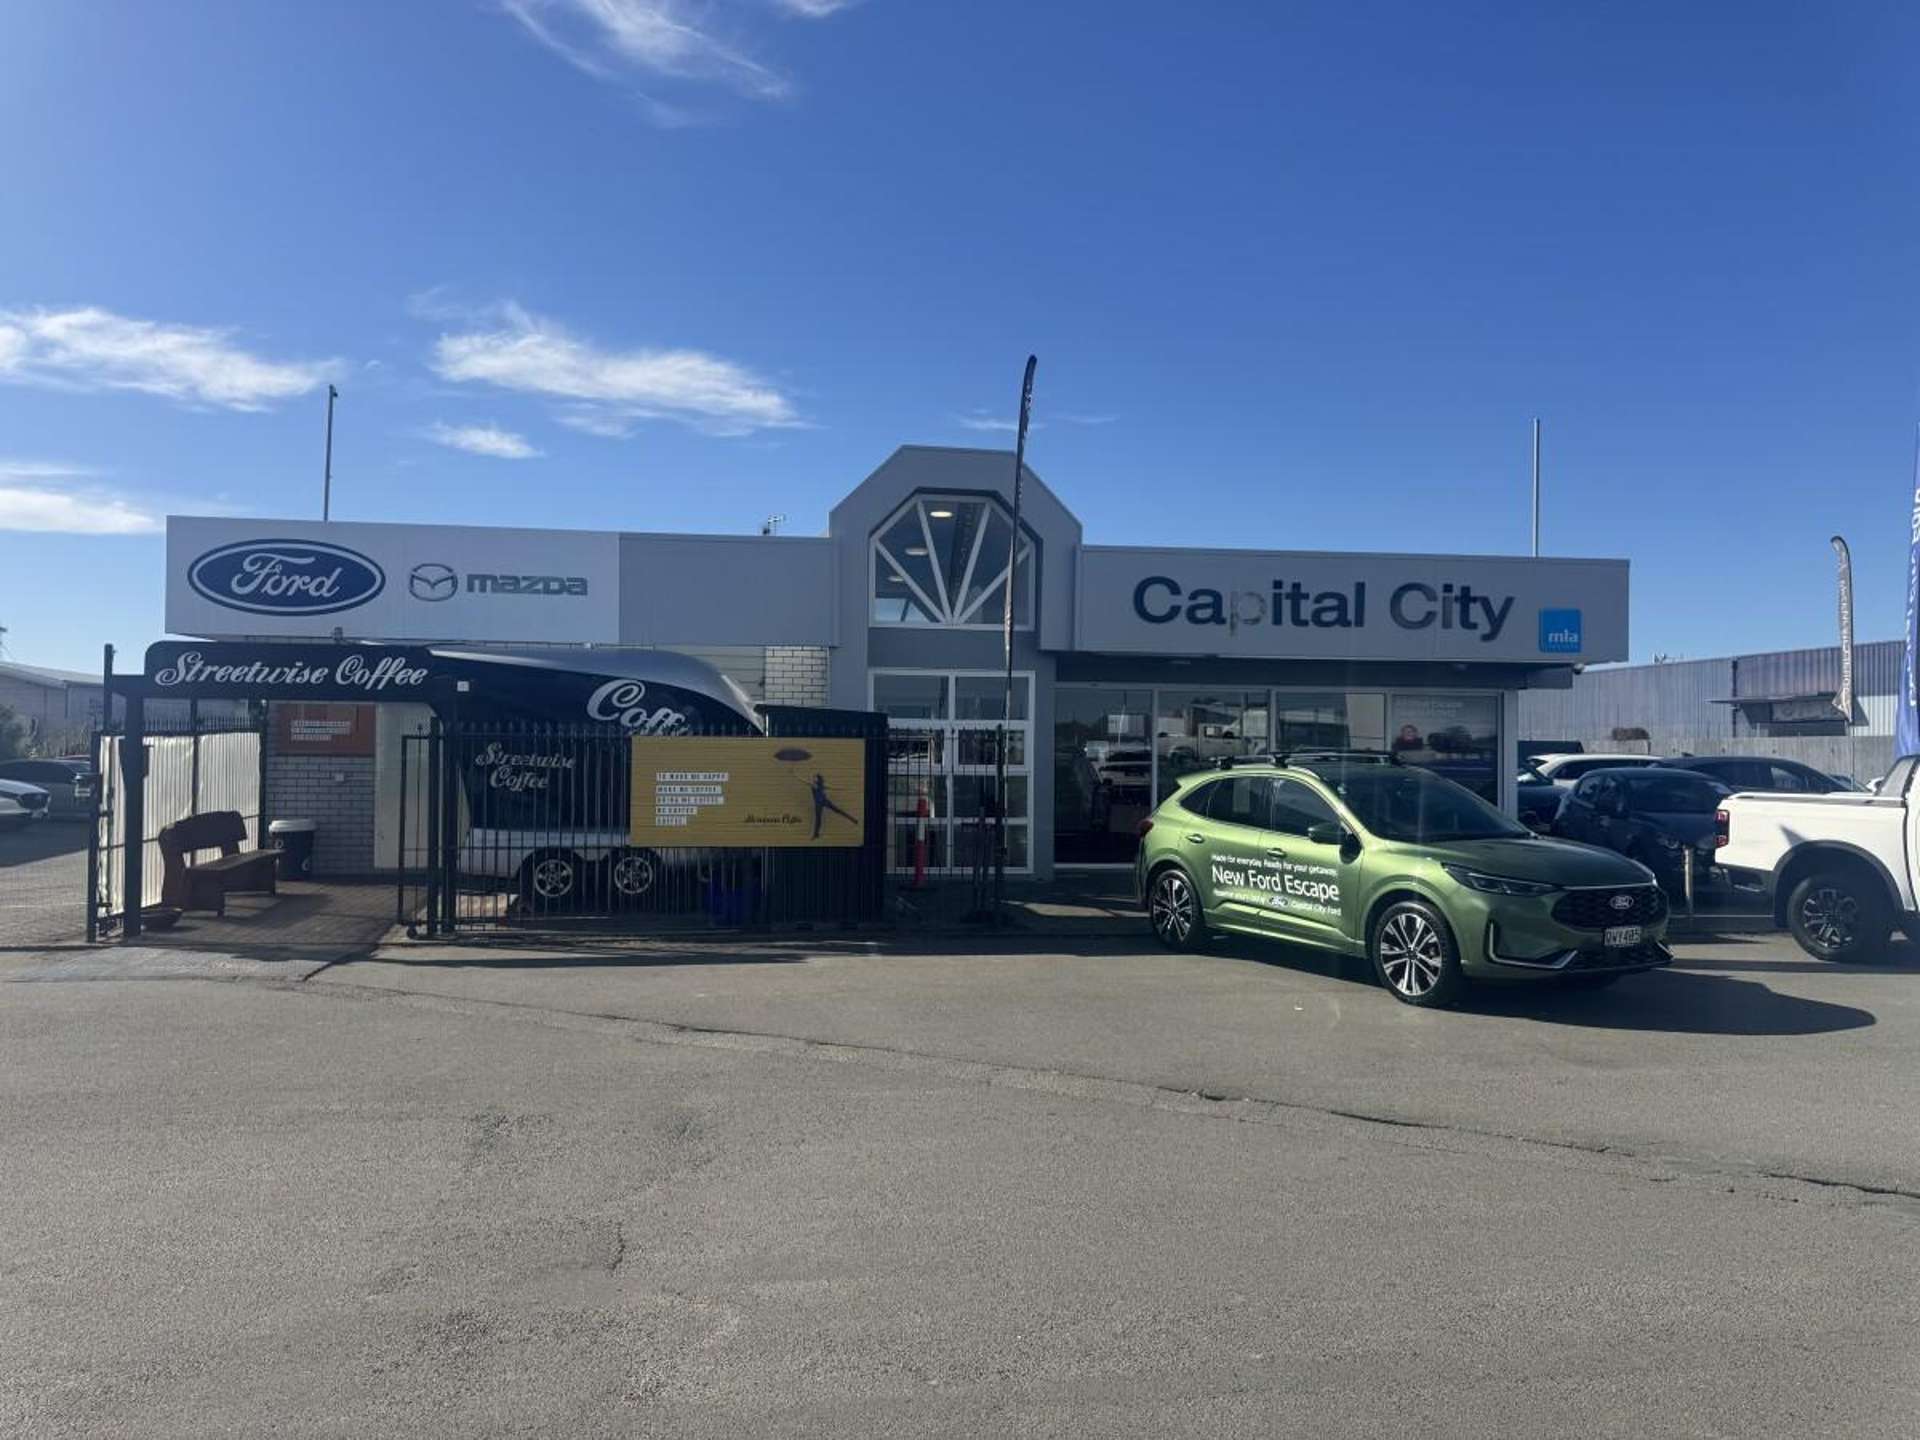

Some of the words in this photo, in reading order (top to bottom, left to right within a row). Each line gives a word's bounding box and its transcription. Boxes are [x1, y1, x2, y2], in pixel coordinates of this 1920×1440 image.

[230, 552, 342, 598] Ford
[466, 572, 588, 597] mazda
[1132, 575, 1367, 638] Capital
[1389, 580, 1516, 643] City
[1548, 628, 1579, 643] mla
[154, 650, 329, 686] Streetwise
[335, 653, 428, 691] Coffee
[1211, 864, 1245, 887] New
[1247, 869, 1282, 892] Ford
[1284, 873, 1340, 903] Escape
